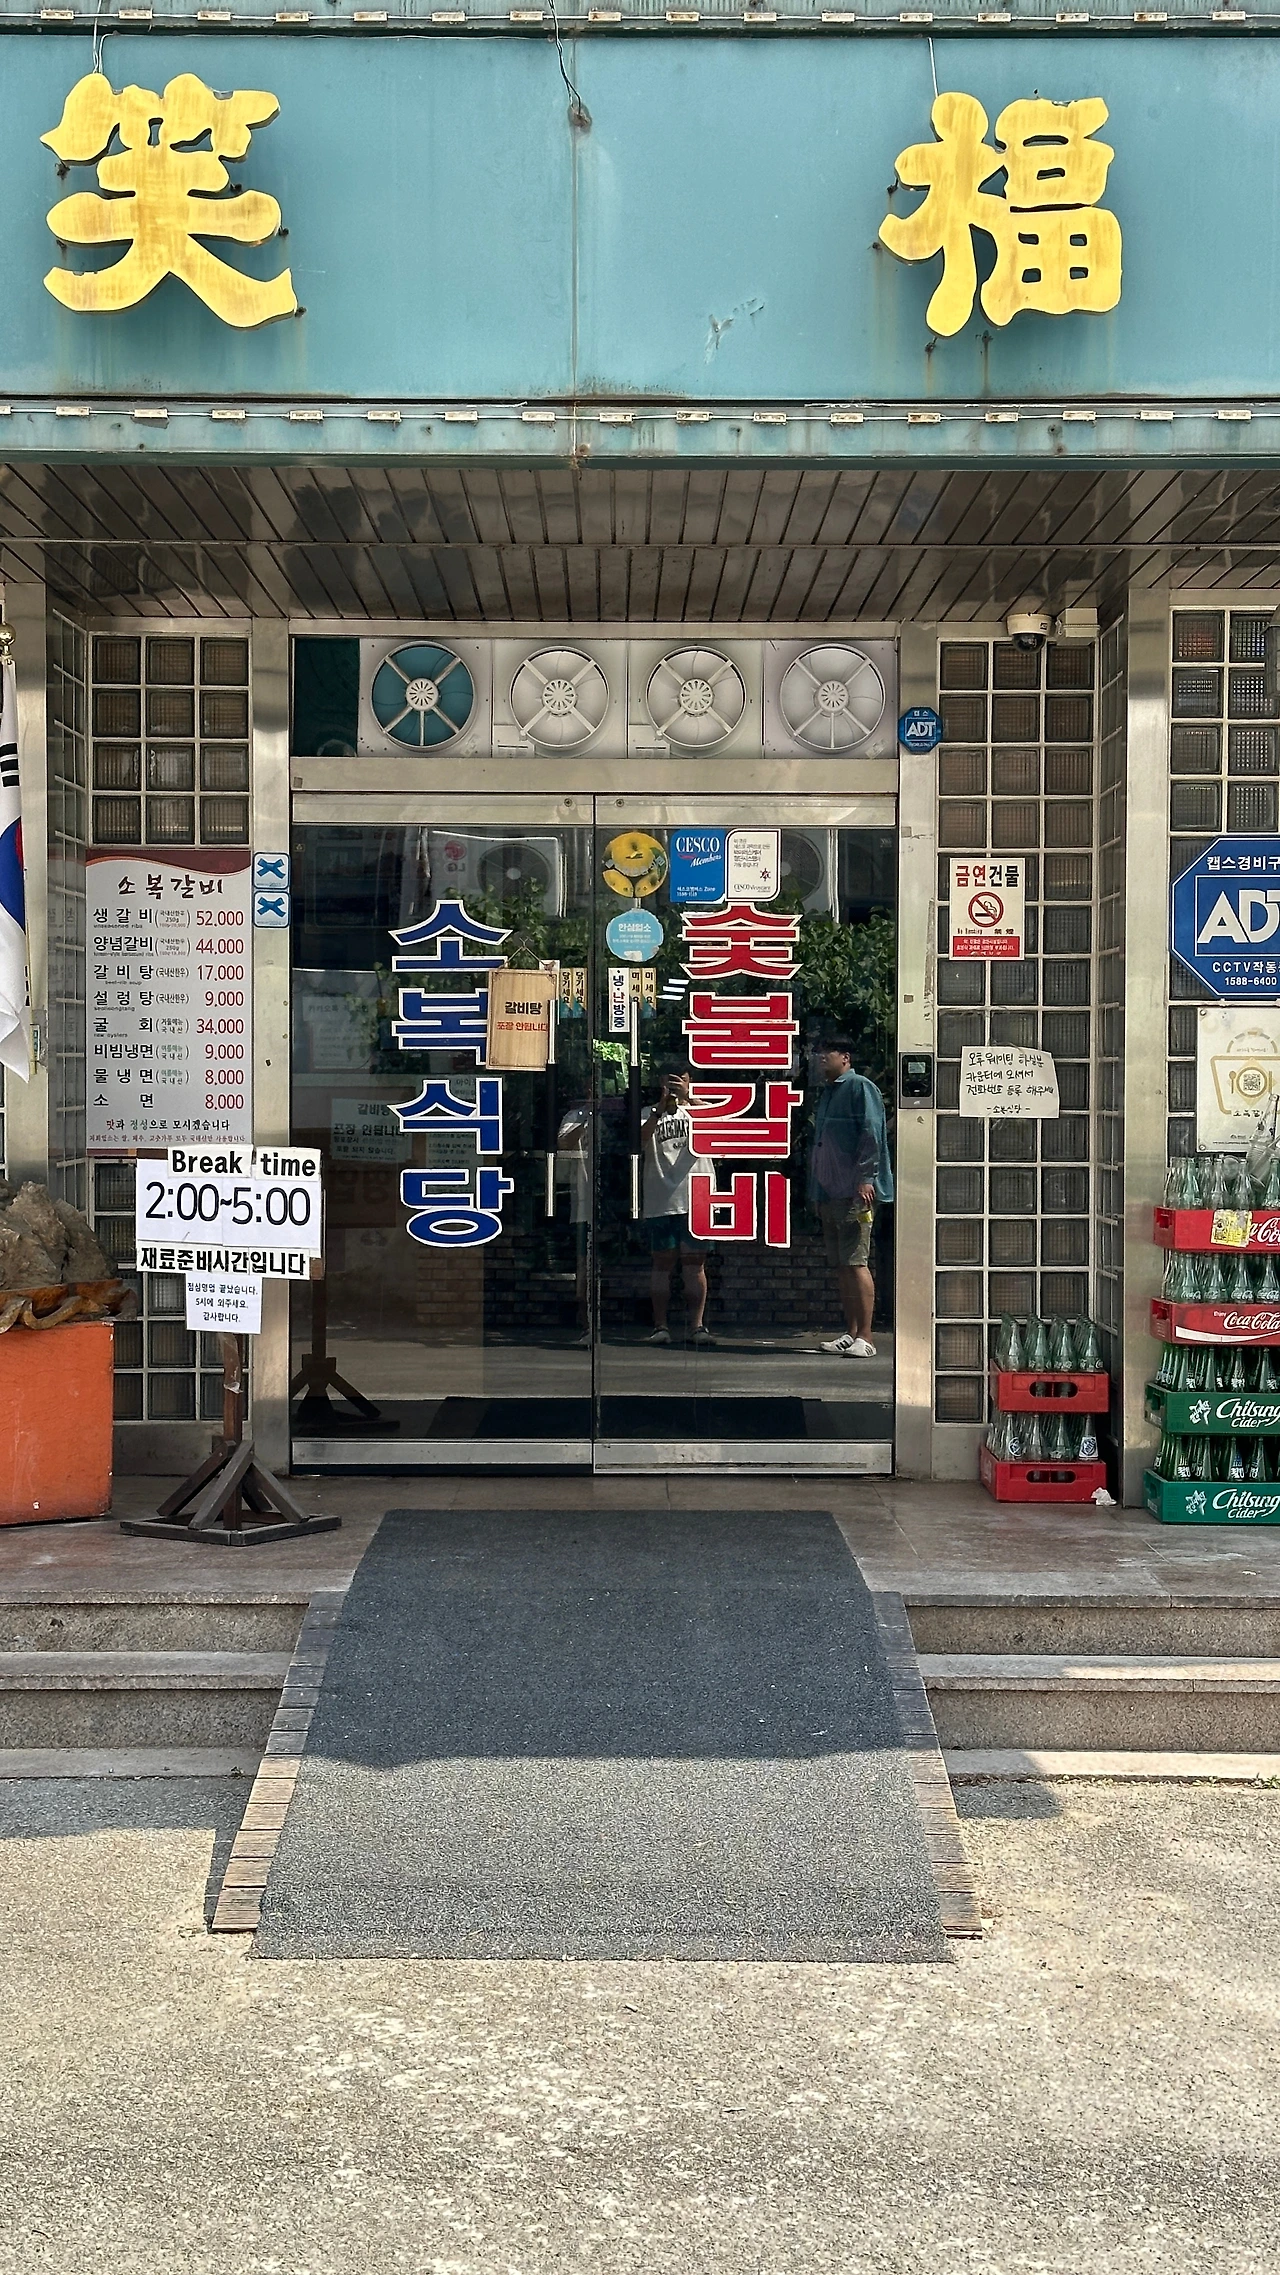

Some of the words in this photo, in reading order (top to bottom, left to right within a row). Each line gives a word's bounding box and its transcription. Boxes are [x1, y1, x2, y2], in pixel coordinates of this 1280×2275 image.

[879, 91, 1123, 338] 福
[906, 721, 936, 737] ADT
[676, 837, 720, 853] CESCO
[690, 853, 722, 868] Members
[956, 864, 1020, 888] 금연건물
[118, 873, 224, 900] 소복갈비
[93, 936, 153, 951] 양념갈비
[575, 971, 585, 1004] 당기세요
[1224, 976, 1277, 986] 1588-6400
[504, 1001, 543, 1015] 갈비탕
[94, 1043, 154, 1059] 비빔냉면
[388, 899, 514, 1248] 소복식당
[679, 902, 804, 1249] 숯불갈비
[106, 1119, 125, 1131] 맛과
[130, 1119, 168, 1130] 정성으로
[172, 1119, 230, 1131] 모시겠습니다
[172, 1150, 243, 1174] Break
[260, 1152, 316, 1176] time
[145, 1181, 311, 1227] 2:00~5:00
[140, 1247, 306, 1276] 재료준비시간입니다
[187, 1282, 216, 1293] 점심영업
[195, 1297, 214, 1307] 5시에
[203, 1311, 241, 1323] 감사합니다.
[1230, 1417, 1271, 1428] Cider
[1227, 1507, 1266, 1518] Cider
